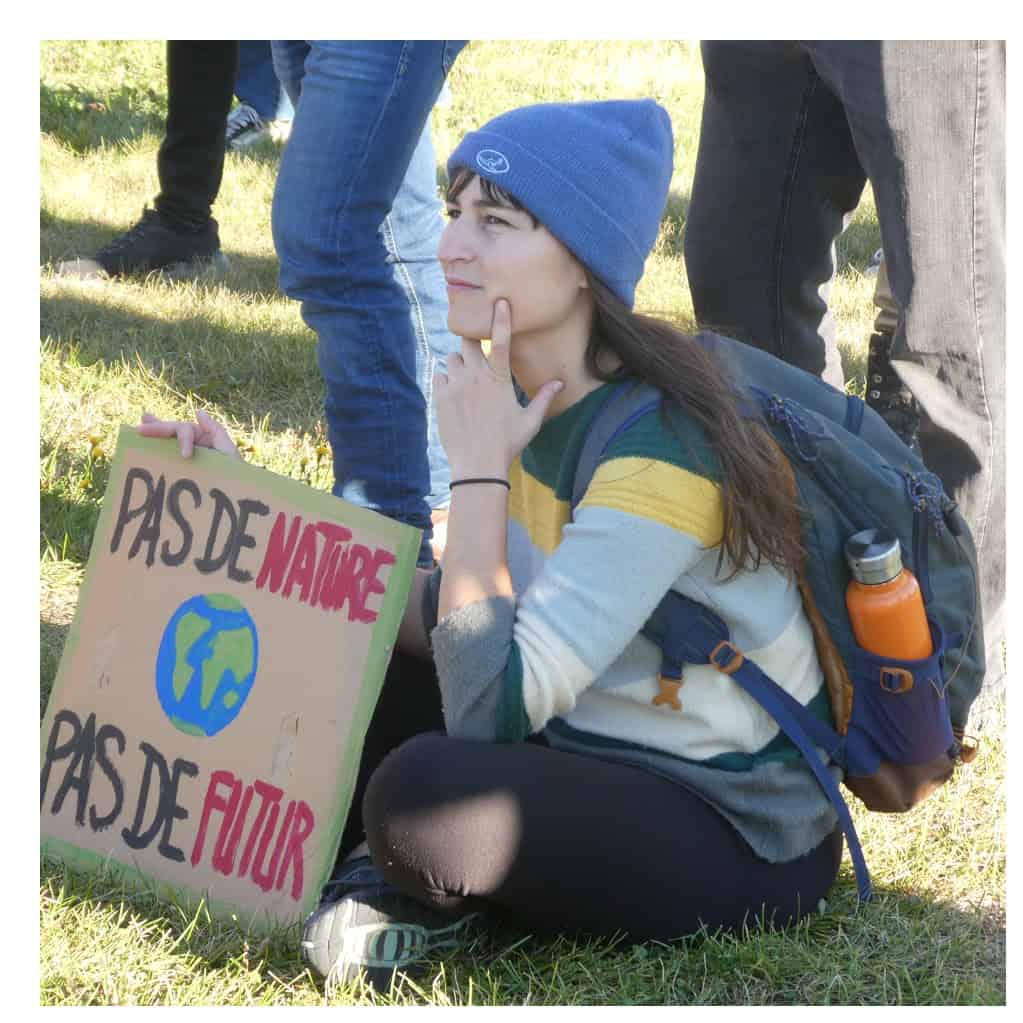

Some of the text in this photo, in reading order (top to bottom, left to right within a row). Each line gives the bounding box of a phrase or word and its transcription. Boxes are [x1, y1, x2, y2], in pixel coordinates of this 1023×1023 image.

[111, 468, 396, 625] PAS DE NATURE
[40, 708, 316, 900] PAS DE FUTUR
